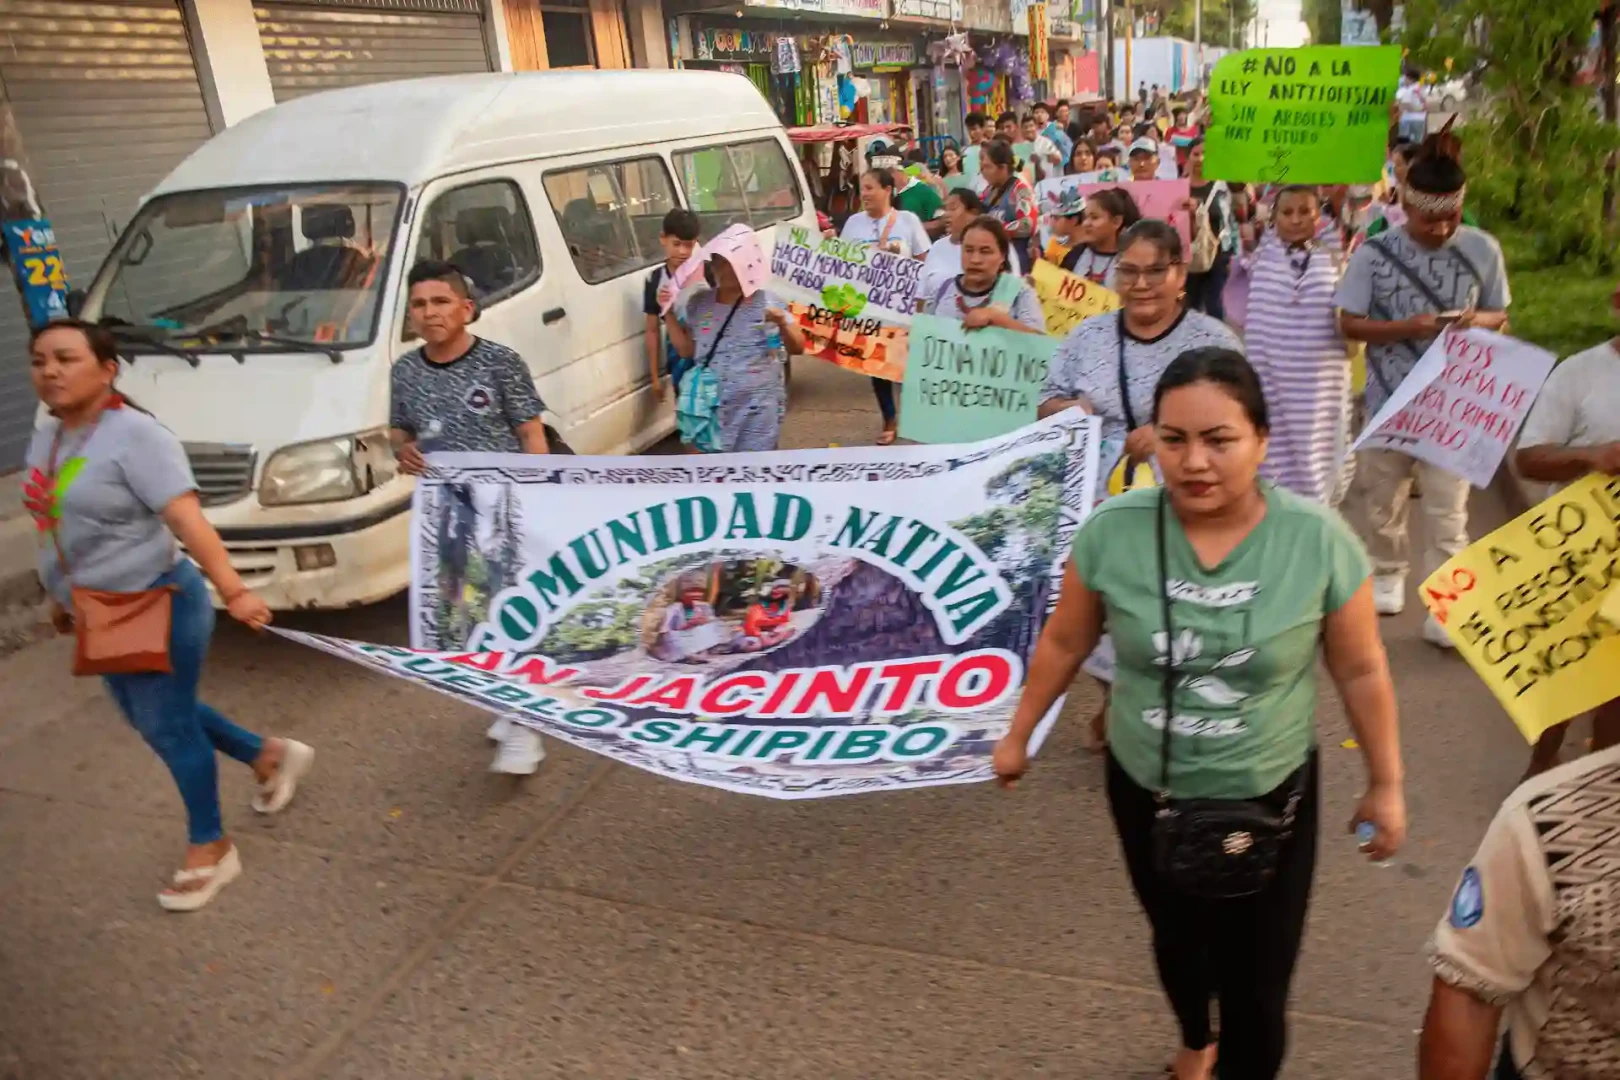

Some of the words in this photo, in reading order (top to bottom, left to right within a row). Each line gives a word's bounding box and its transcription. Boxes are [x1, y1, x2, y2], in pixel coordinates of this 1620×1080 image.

[1309, 60, 1321, 76] A
[1332, 60, 1352, 76] LA
[1231, 103, 1258, 123] SIN
[772, 241, 813, 268] HACEN
[812, 253, 858, 281] MENOS
[770, 259, 788, 278] UN
[867, 286, 894, 310] QUE
[1058, 275, 1087, 303] NO
[921, 335, 974, 376] DINA
[980, 346, 1009, 379] NO
[1014, 353, 1050, 384] NOS
[919, 377, 1029, 413] REPRESENTA
[829, 505, 1001, 636] NATIVA
[408, 647, 580, 686] AN
[582, 653, 1011, 714] JACINTO
[631, 720, 949, 761] SHIPIBO
